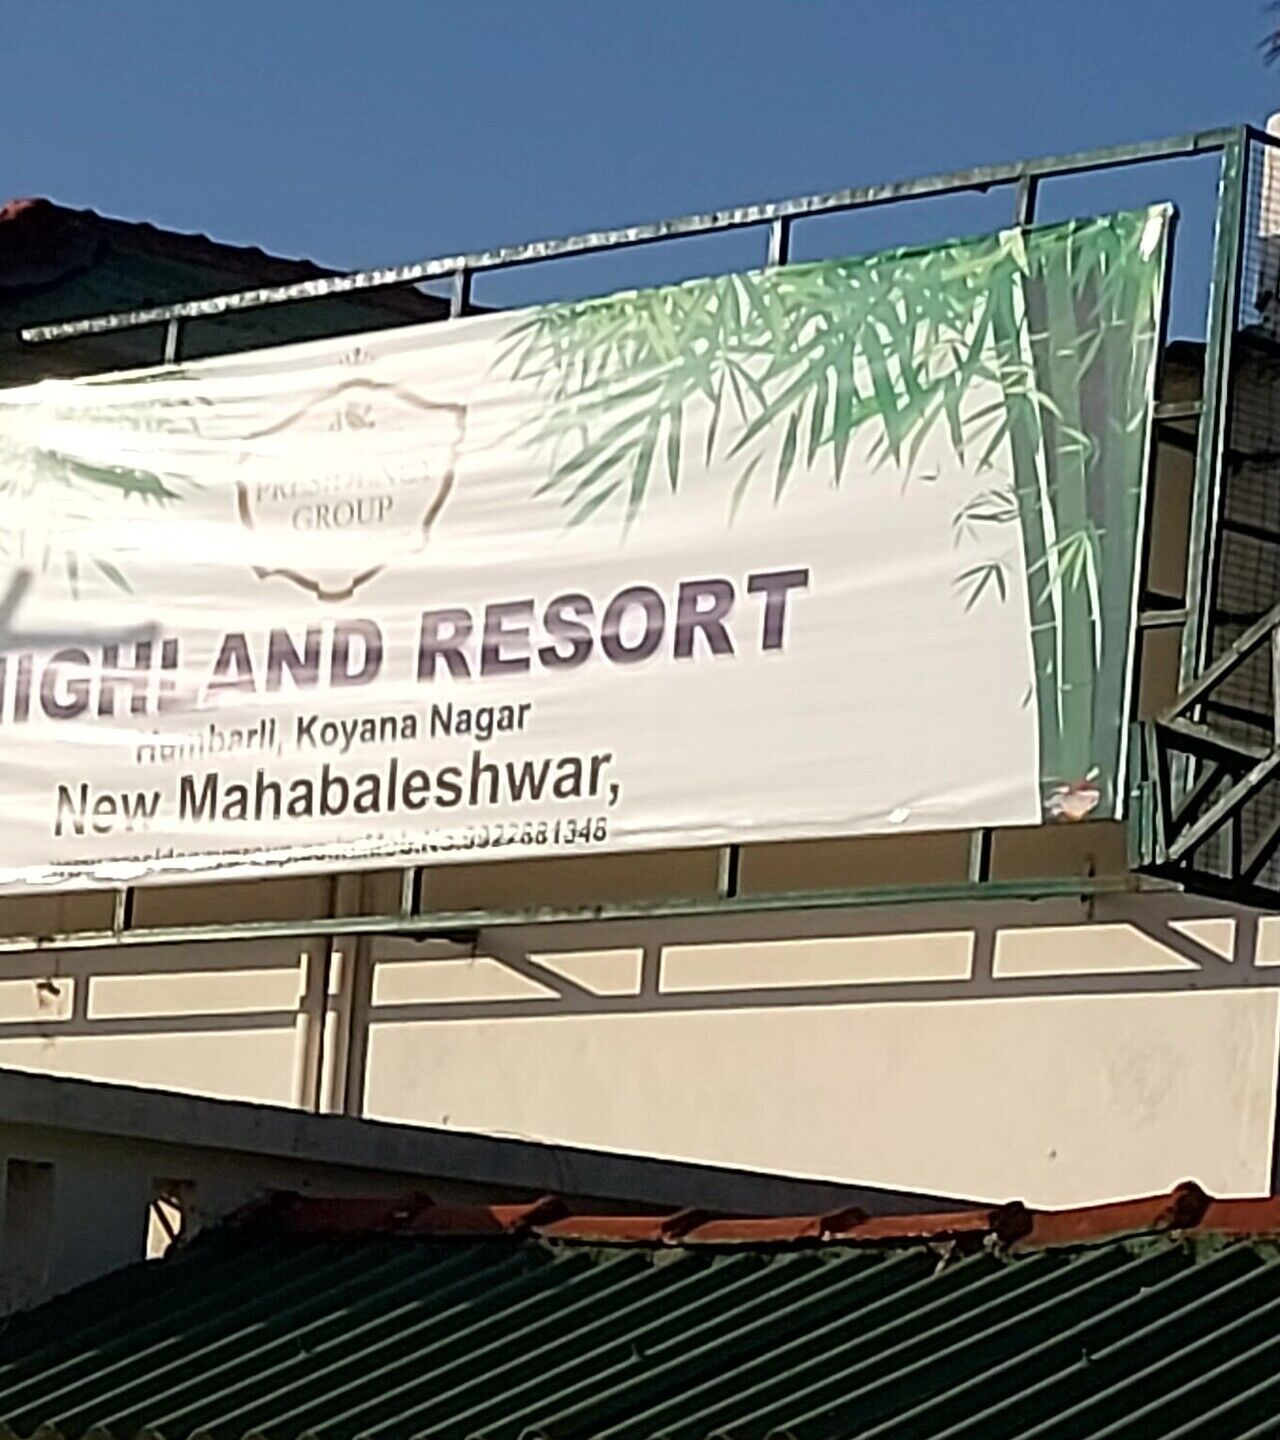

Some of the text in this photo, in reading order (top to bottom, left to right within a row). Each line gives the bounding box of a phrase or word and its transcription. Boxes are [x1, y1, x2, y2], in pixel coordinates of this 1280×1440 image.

[292, 496, 393, 531] GROUP
[418, 568, 810, 682] RESORT
[296, 713, 417, 753] Koyana
[430, 702, 532, 741] Nagar
[53, 751, 620, 837] New Mahabaleshwar,
